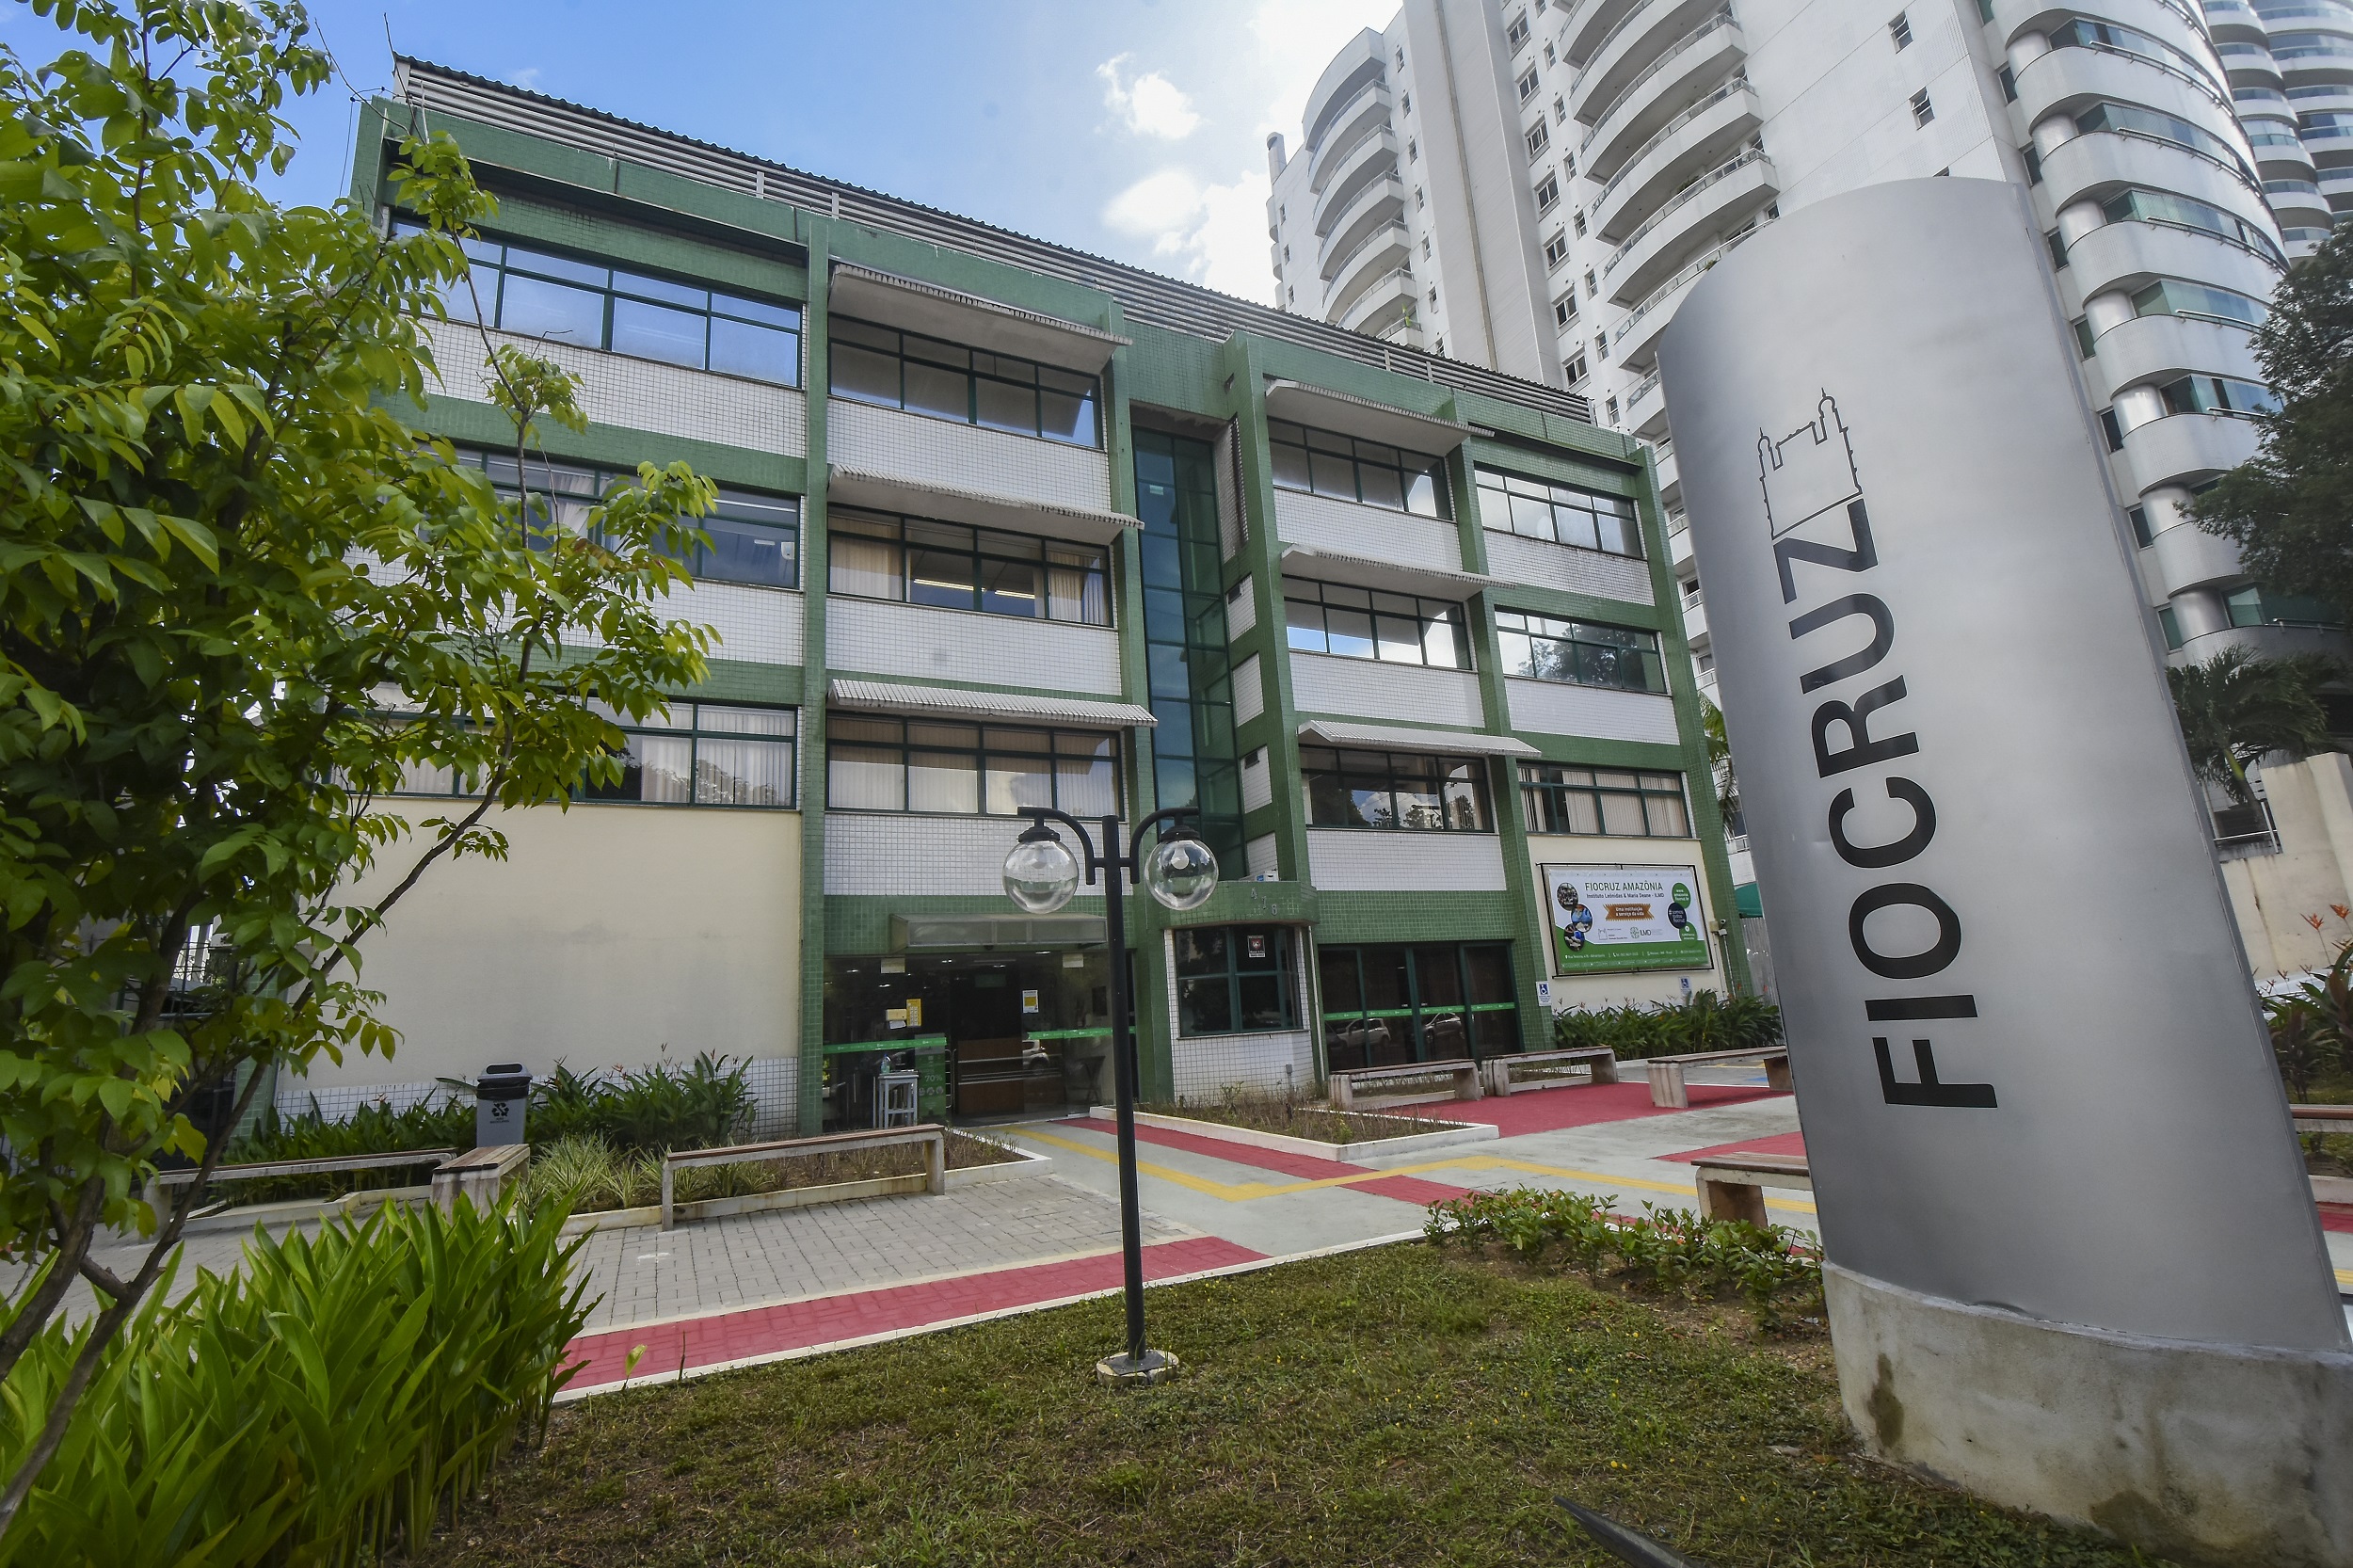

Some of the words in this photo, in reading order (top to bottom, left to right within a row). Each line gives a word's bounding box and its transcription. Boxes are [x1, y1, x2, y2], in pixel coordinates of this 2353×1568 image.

[1585, 882, 1621, 891] FIOCRUZ
[1623, 880, 1663, 891] AMAZÔNIA
[1773, 498, 1997, 1109] FIOCRUZ
